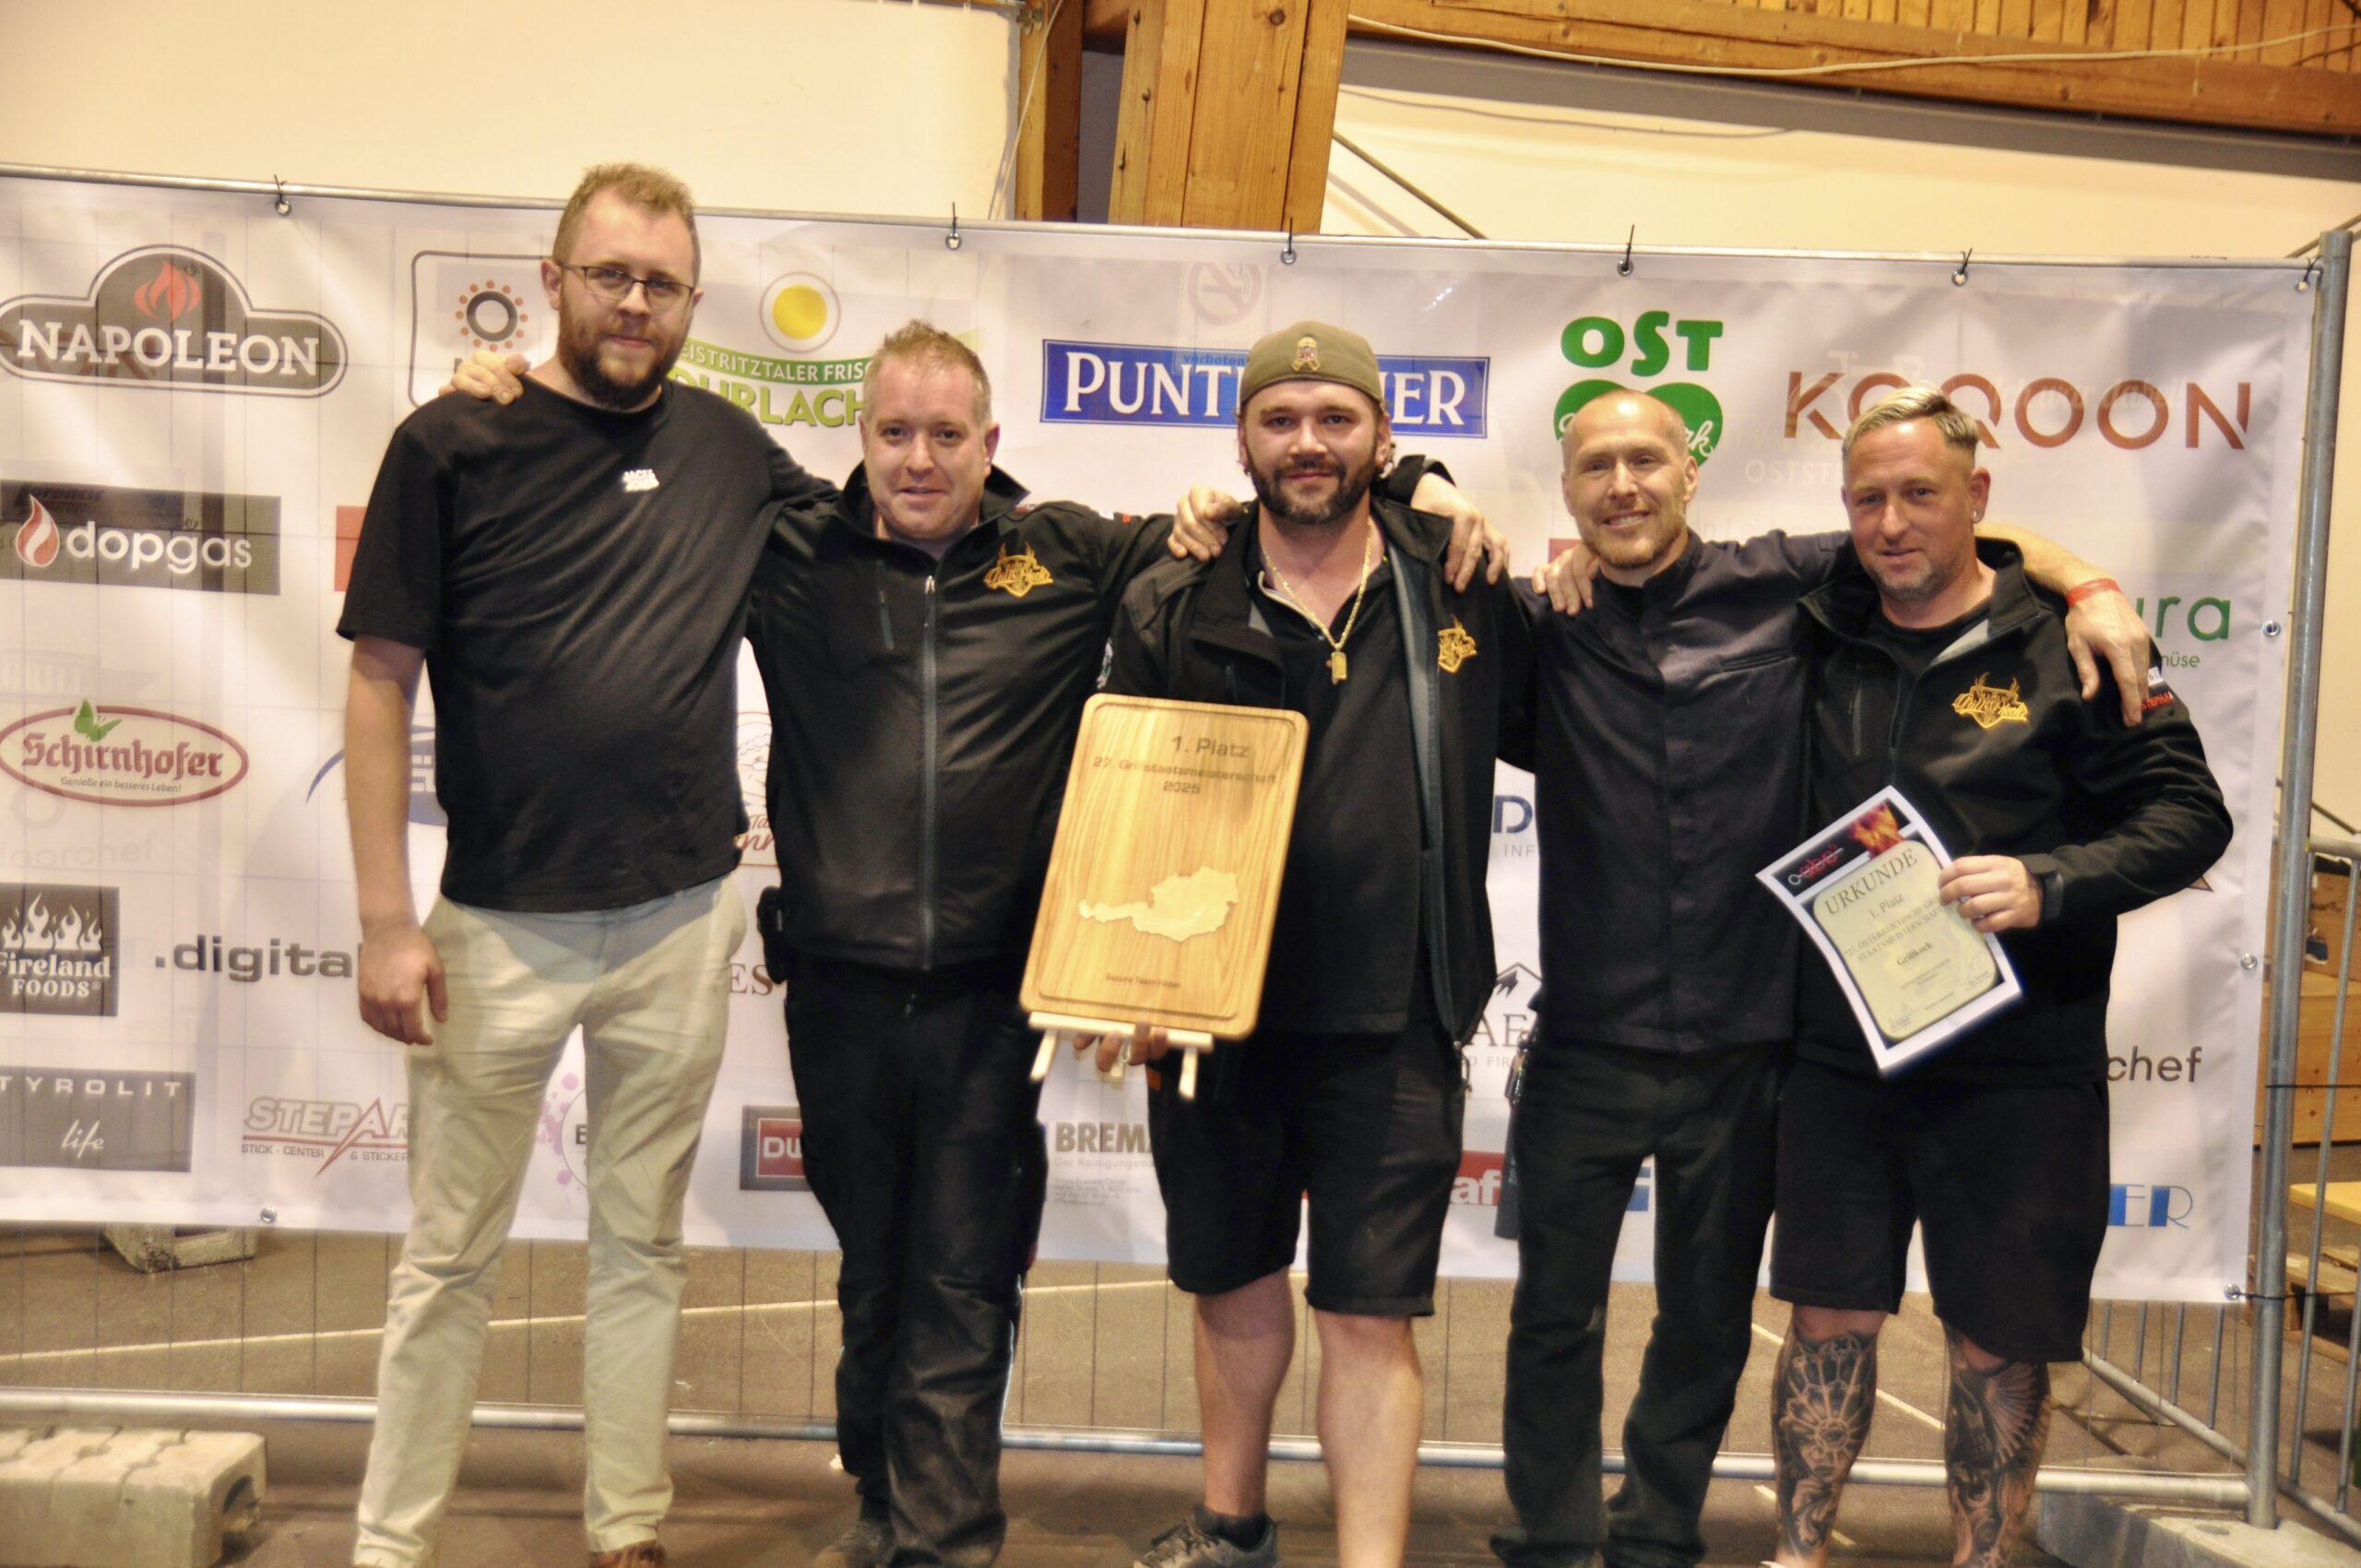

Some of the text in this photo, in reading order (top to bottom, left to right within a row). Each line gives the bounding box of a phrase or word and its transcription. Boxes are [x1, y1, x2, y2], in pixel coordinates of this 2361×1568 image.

[18, 318, 319, 376] NAPOLEON
[1560, 310, 1723, 376] OST
[66, 521, 252, 574] dopgas
[2135, 596, 2230, 641] ra
[21, 731, 225, 779] Schirnhofer
[1172, 735, 1251, 758] 1. Platz
[61, 777, 182, 793] Genieße ein besseres Leben!
[1824, 848, 1918, 916] URKUNDE
[1879, 893, 1905, 913] Platz
[156, 934, 362, 983] .digita
[0, 1076, 182, 1097] TYROLIT
[61, 1119, 104, 1160] life
[242, 1144, 273, 1155] STICK
[283, 1146, 325, 1158] CENTER
[1055, 1122, 1151, 1153] BREM
